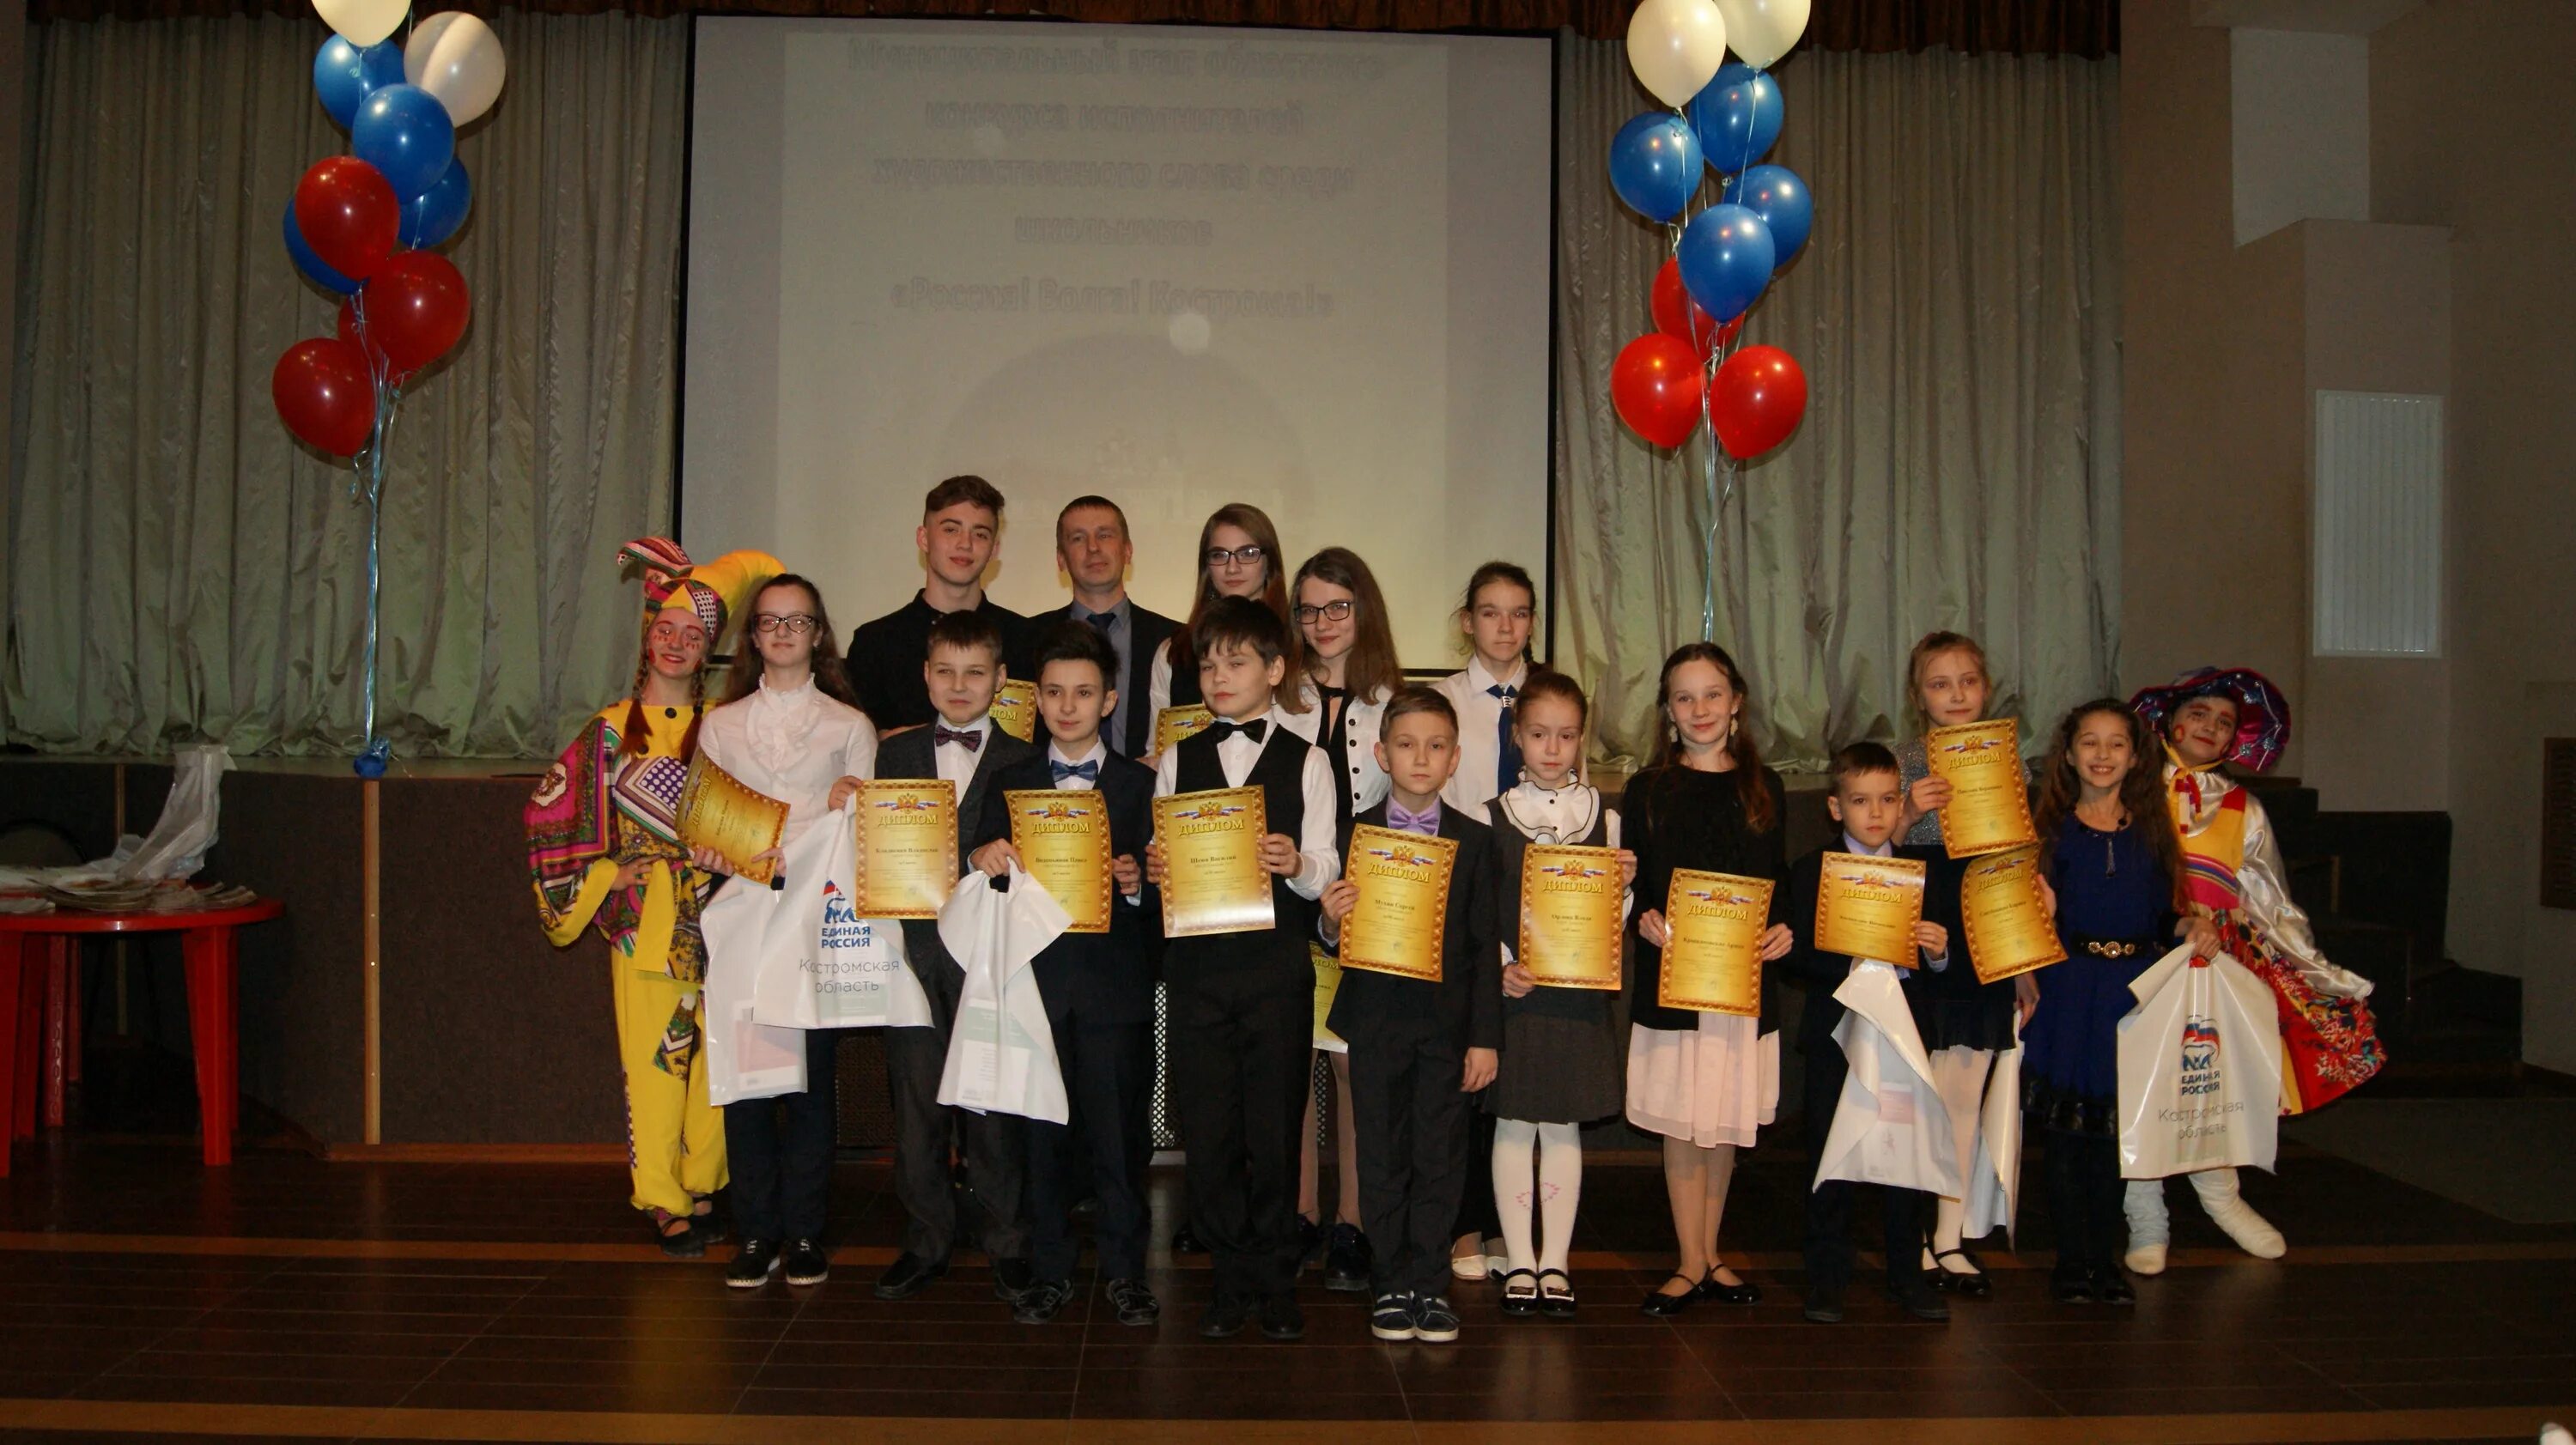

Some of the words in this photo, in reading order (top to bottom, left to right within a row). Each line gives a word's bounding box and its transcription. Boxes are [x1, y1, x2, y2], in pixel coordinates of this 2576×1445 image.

[925, 102, 1068, 134] конкурса
[1078, 100, 1304, 135] исполнителей
[872, 158, 1151, 191] художественного
[1161, 163, 1249, 189] слова
[1258, 165, 1353, 198] среди
[1015, 216, 1212, 246] школьников
[1039, 277, 1140, 314] Волга!
[1948, 751, 2001, 769] ДИПЛОМ
[878, 815, 939, 827] ДИПЛОМ
[1178, 819, 1244, 836] ДИПЛОМ
[1031, 823, 1091, 835] ДИПЛОМ
[1368, 863, 1431, 883] ДИПЛОМ
[1543, 880, 1603, 893] ДИПЛОМ
[1840, 888, 1903, 903] ДИПЛОМ
[1687, 905, 1748, 920] ДИПЛОМ
[822, 926, 871, 938] ЕДИНАЯ
[822, 938, 871, 949] РОССИЯ
[799, 959, 900, 975] Костромская
[815, 980, 879, 993] область
[2182, 1070, 2221, 1084] ЕДИНАЯ
